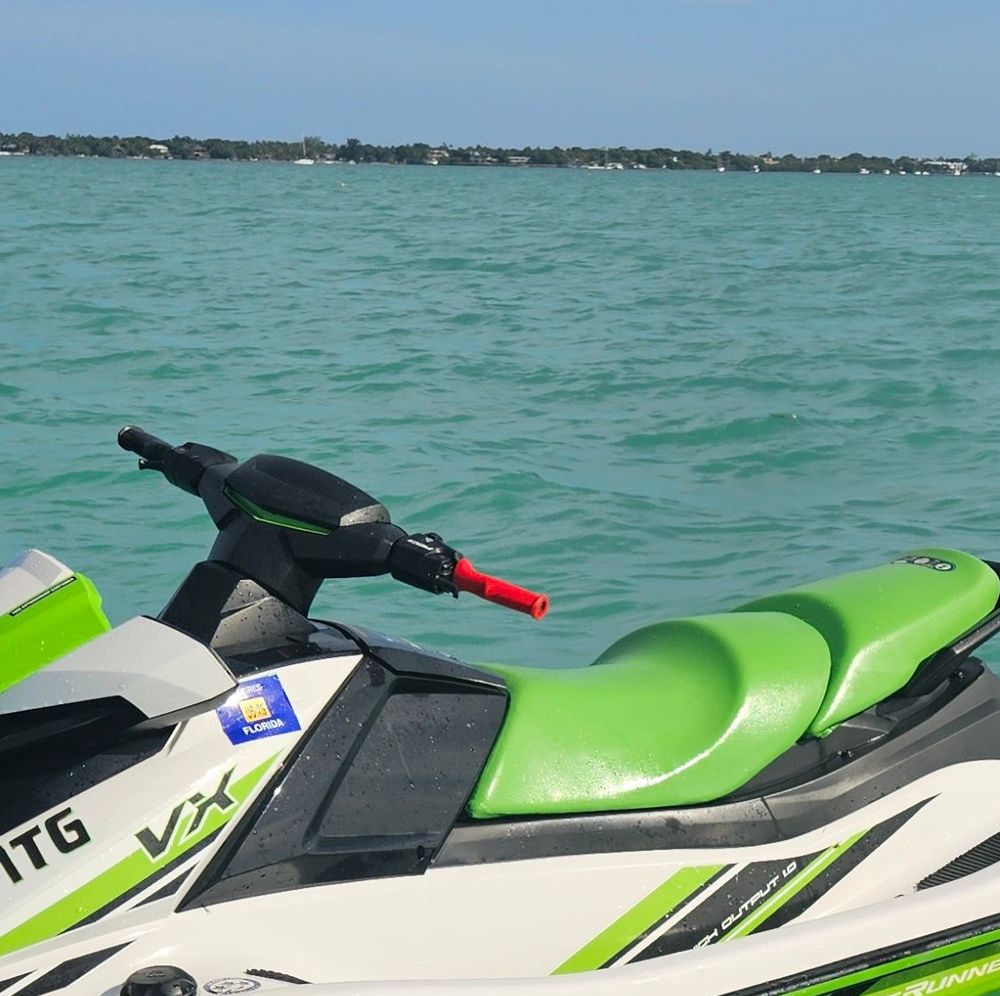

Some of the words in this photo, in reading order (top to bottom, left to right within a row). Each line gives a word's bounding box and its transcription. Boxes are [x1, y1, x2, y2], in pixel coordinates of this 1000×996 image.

[242, 718, 285, 736] FLORIDA
[134, 764, 238, 859] VX
[721, 875, 780, 930] OUTPUT
